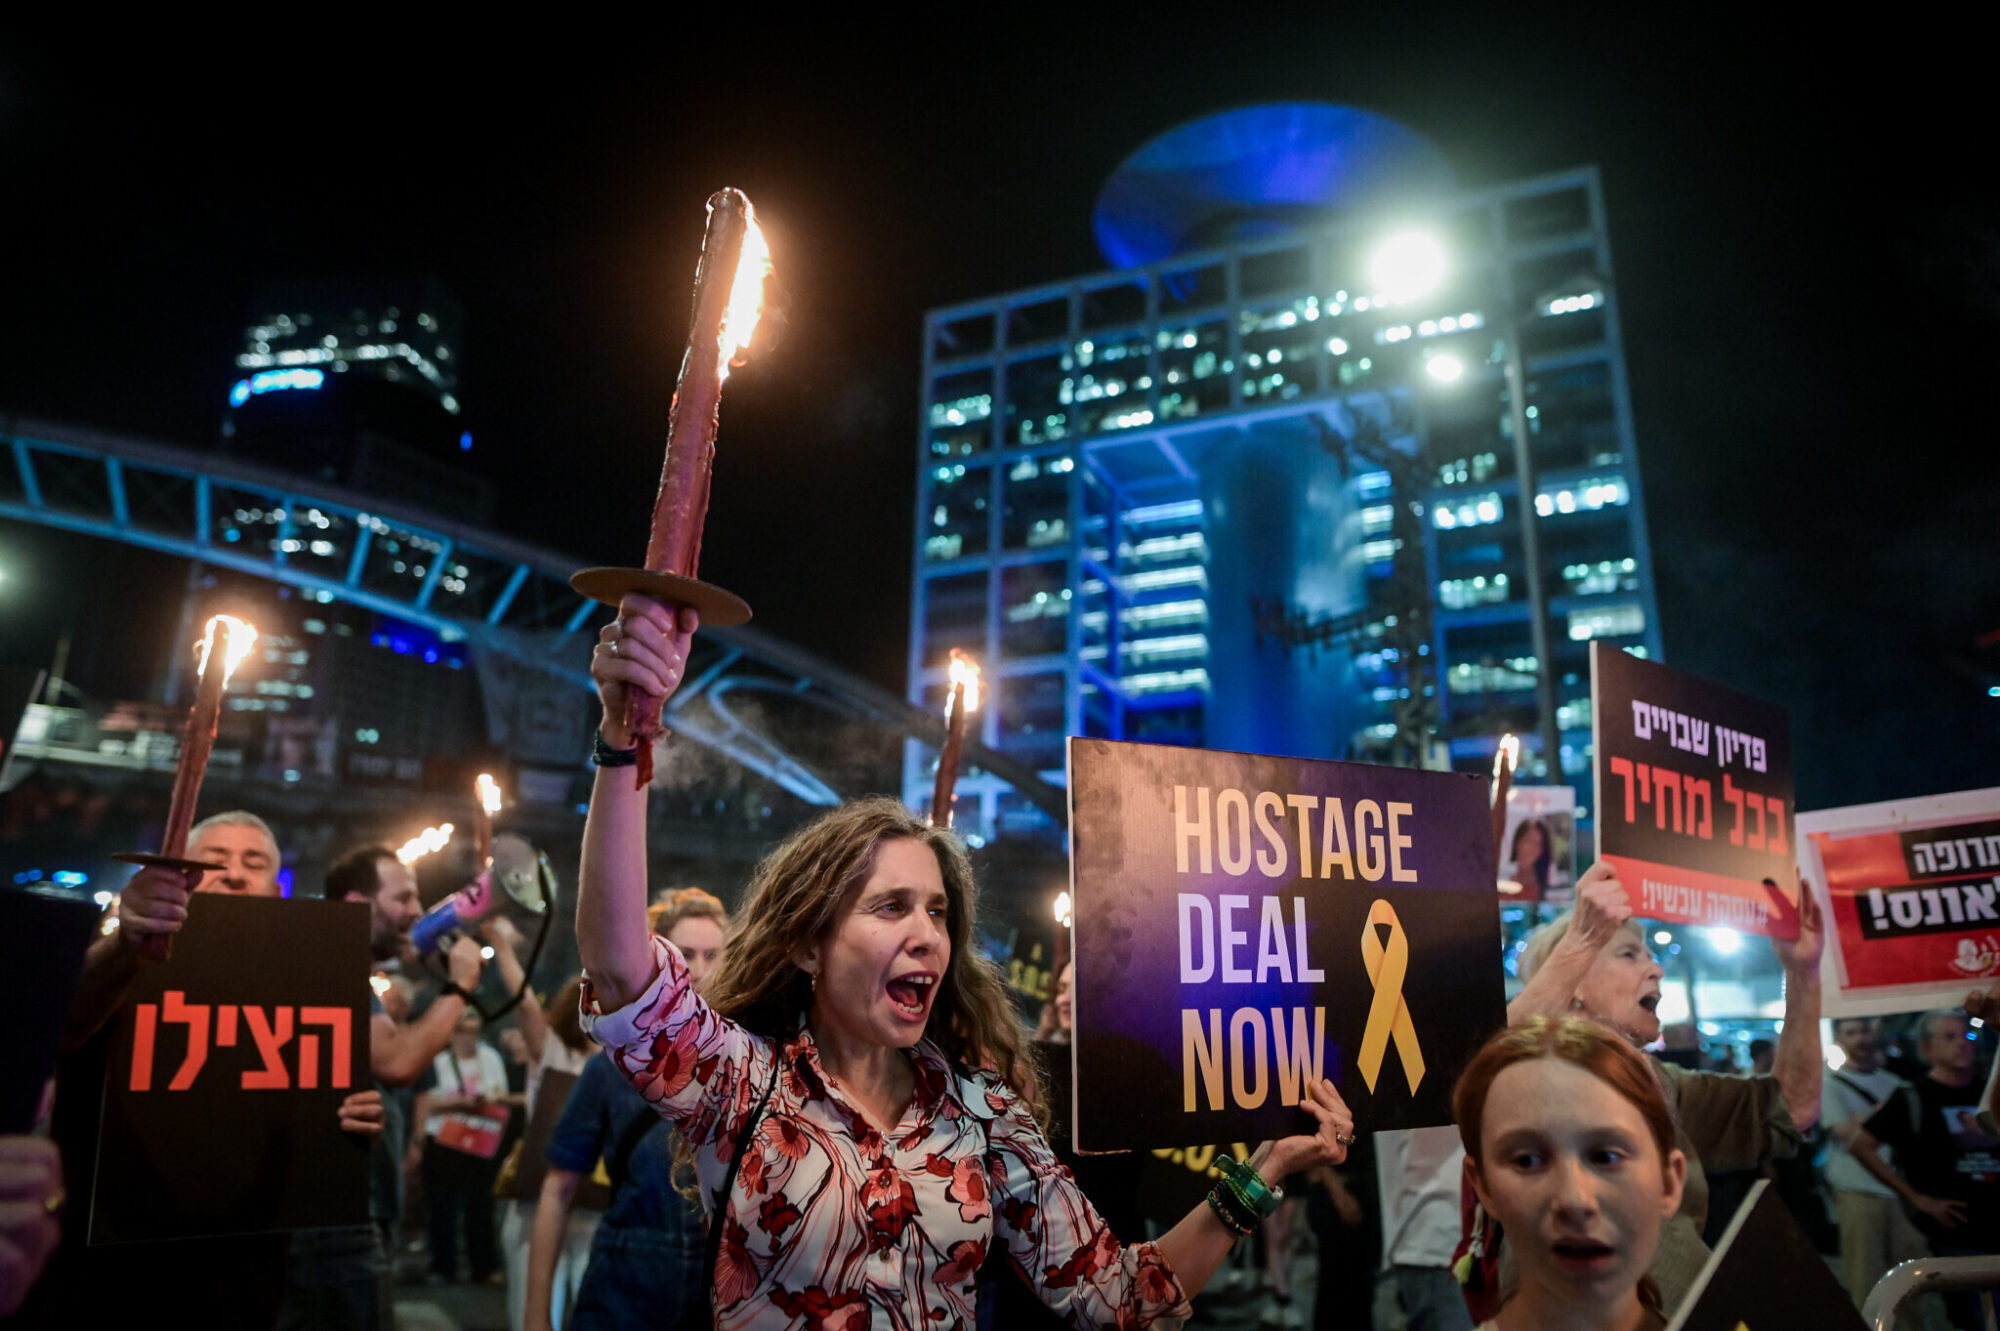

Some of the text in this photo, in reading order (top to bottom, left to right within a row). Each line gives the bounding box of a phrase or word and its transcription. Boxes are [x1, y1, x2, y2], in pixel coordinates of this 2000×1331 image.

[1632, 699, 1767, 773] פדיון שבויים
[1174, 785, 1418, 883] HOSTAGE
[1610, 756, 1788, 857] בכל מחיר
[1178, 893, 1325, 984] DEAL
[1642, 878, 1702, 917] עכשיו!
[129, 990, 352, 1091] הצילו
[1181, 1006, 1326, 1113] NOW
